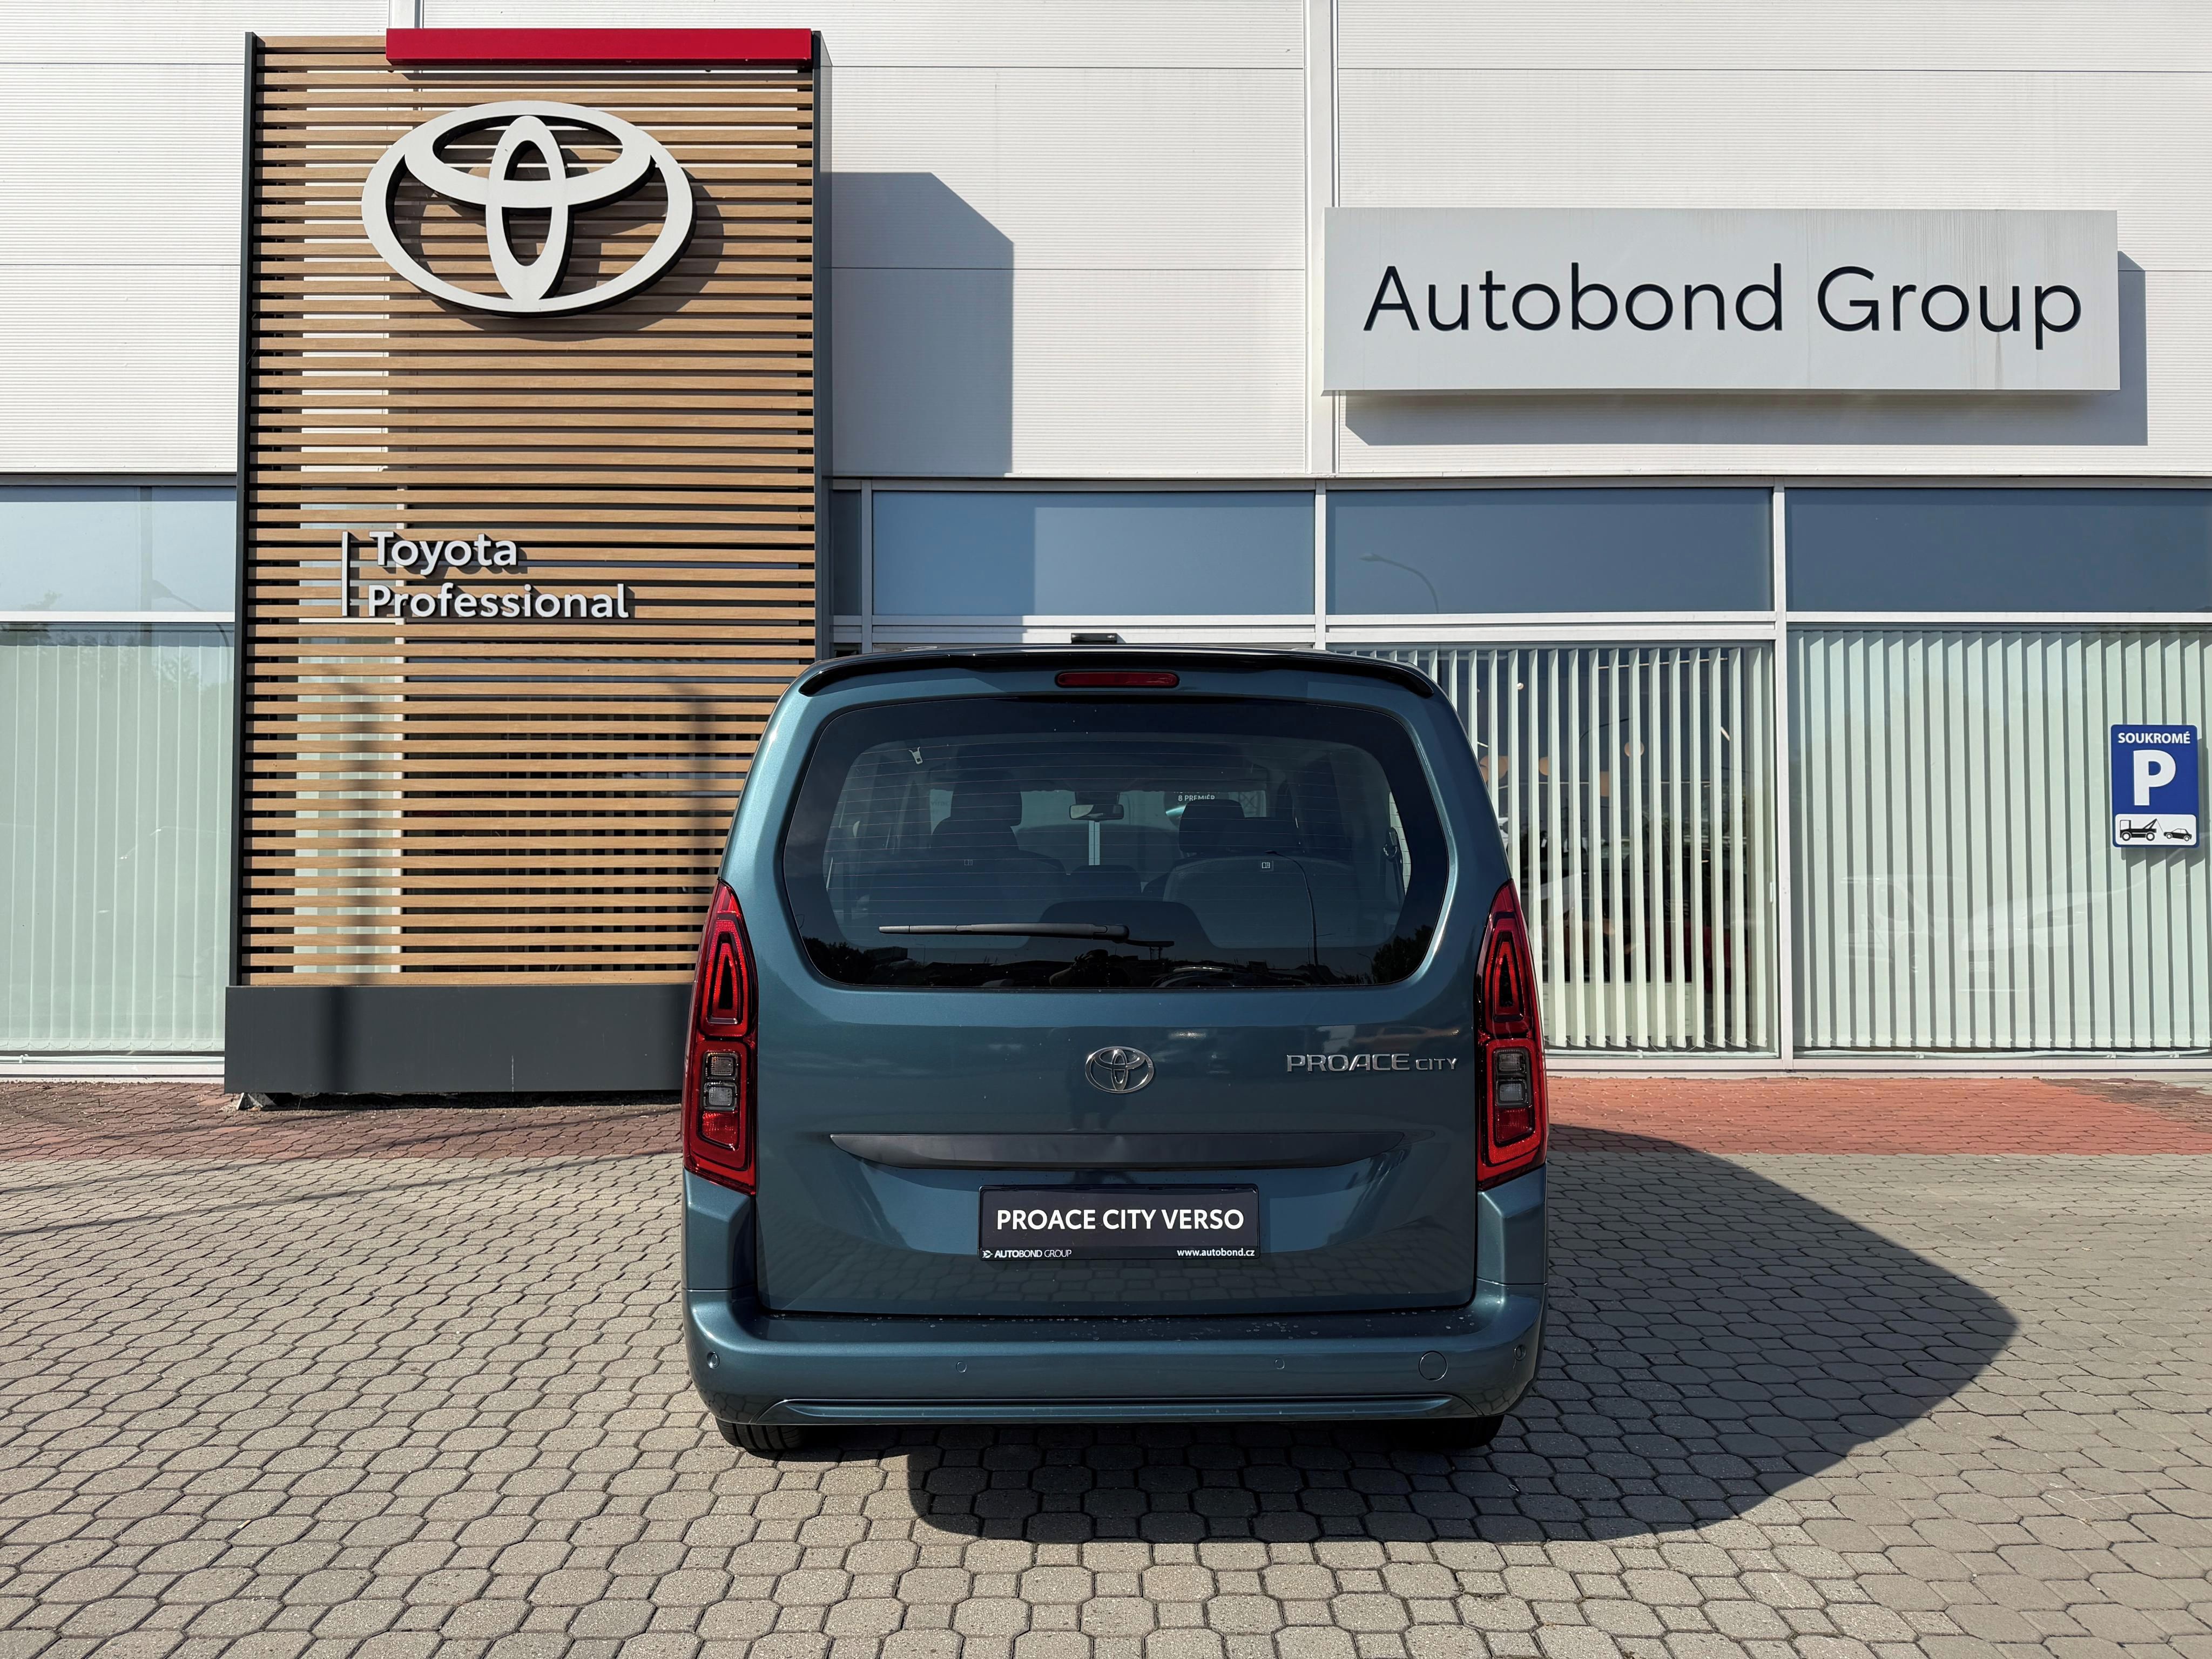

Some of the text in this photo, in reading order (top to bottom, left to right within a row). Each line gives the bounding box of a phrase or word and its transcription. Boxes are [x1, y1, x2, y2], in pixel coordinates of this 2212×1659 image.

[1364, 262, 2082, 350] Autobond Group
[369, 531, 518, 575] Toyota
[368, 582, 629, 618] Professional
[2117, 731, 2191, 744] SOUKROMÉ
[2133, 750, 2176, 806] P
[1286, 1054, 1458, 1072] PROACE CITY
[996, 1209, 1244, 1230] PROACE CITY VERSO
[994, 1249, 1073, 1258] AUTOBOND GROUP
[1177, 1247, 1256, 1258] www.autobond.cz
